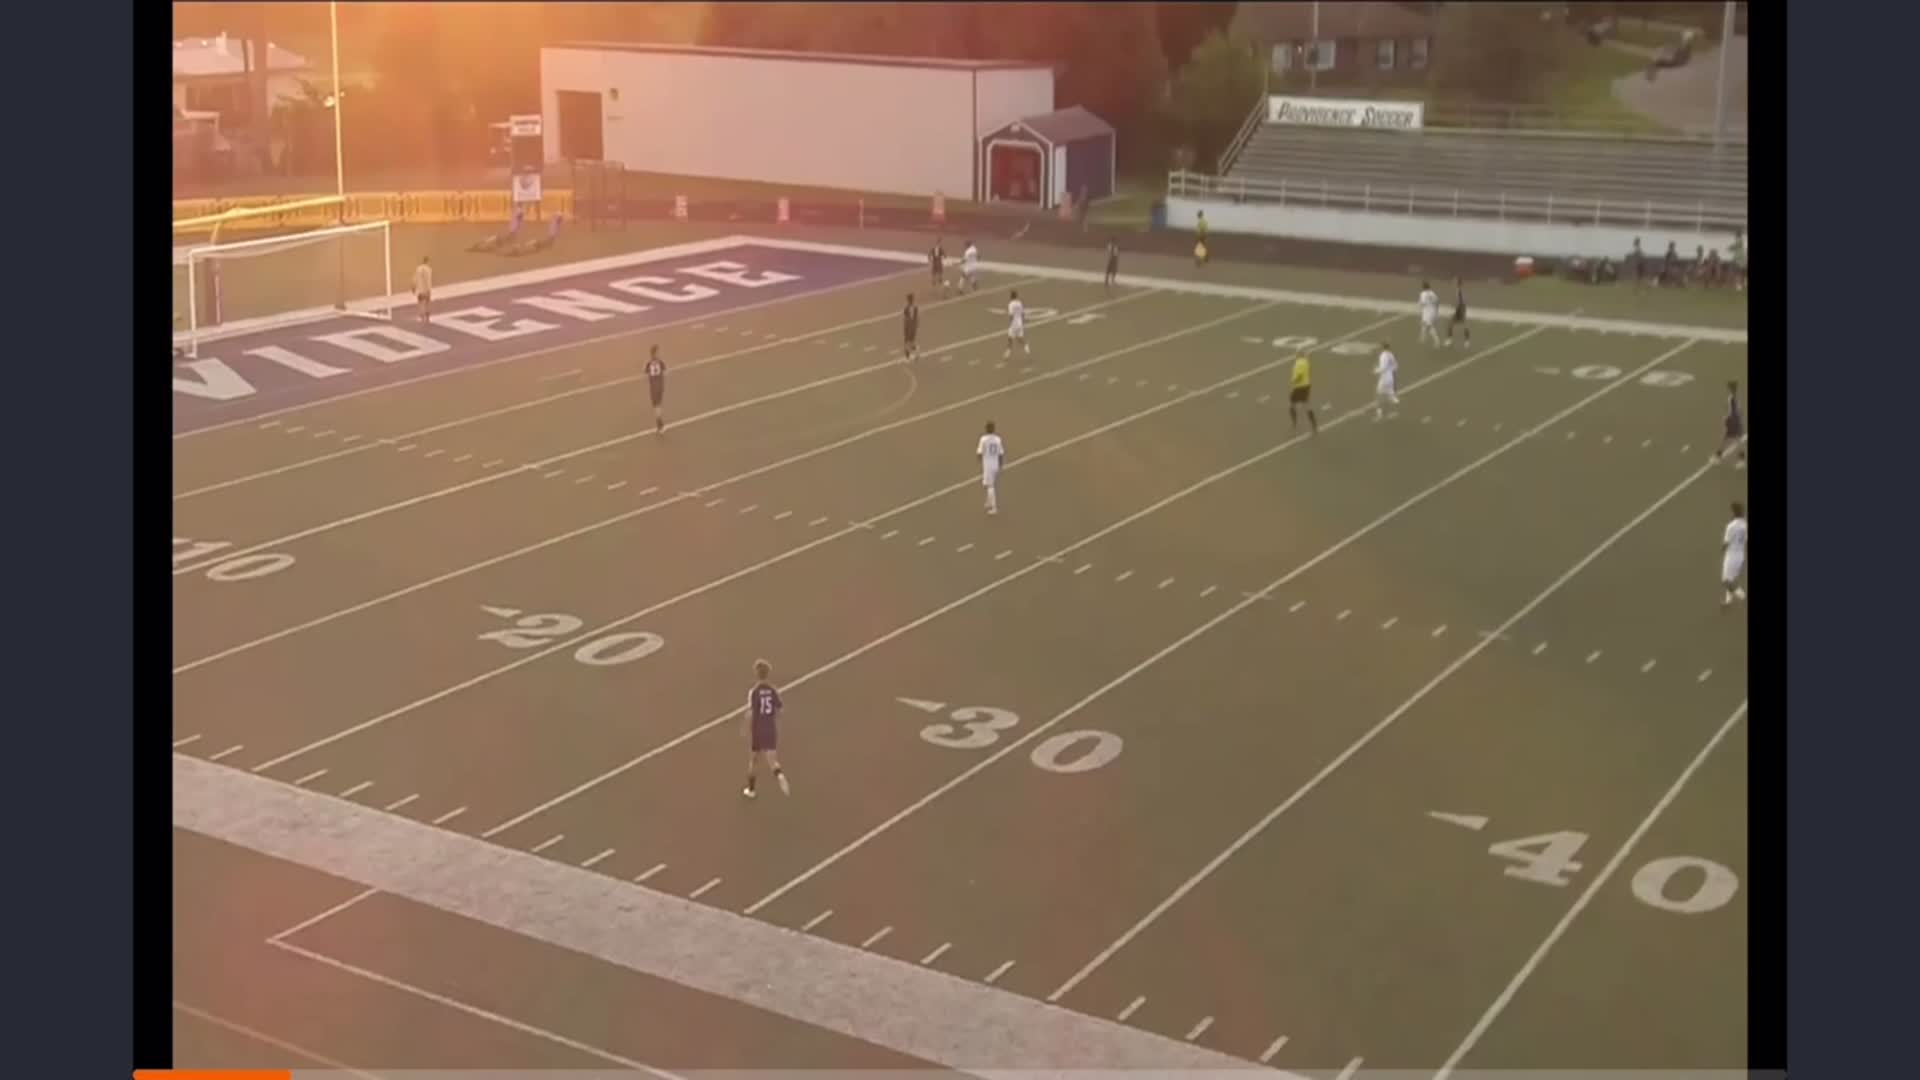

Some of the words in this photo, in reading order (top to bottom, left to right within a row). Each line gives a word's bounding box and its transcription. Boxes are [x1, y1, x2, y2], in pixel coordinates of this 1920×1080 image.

[478, 613, 664, 665] 20
[760, 696, 773, 715] 15
[919, 705, 1123, 773] 30
[1487, 830, 1740, 915] 40
